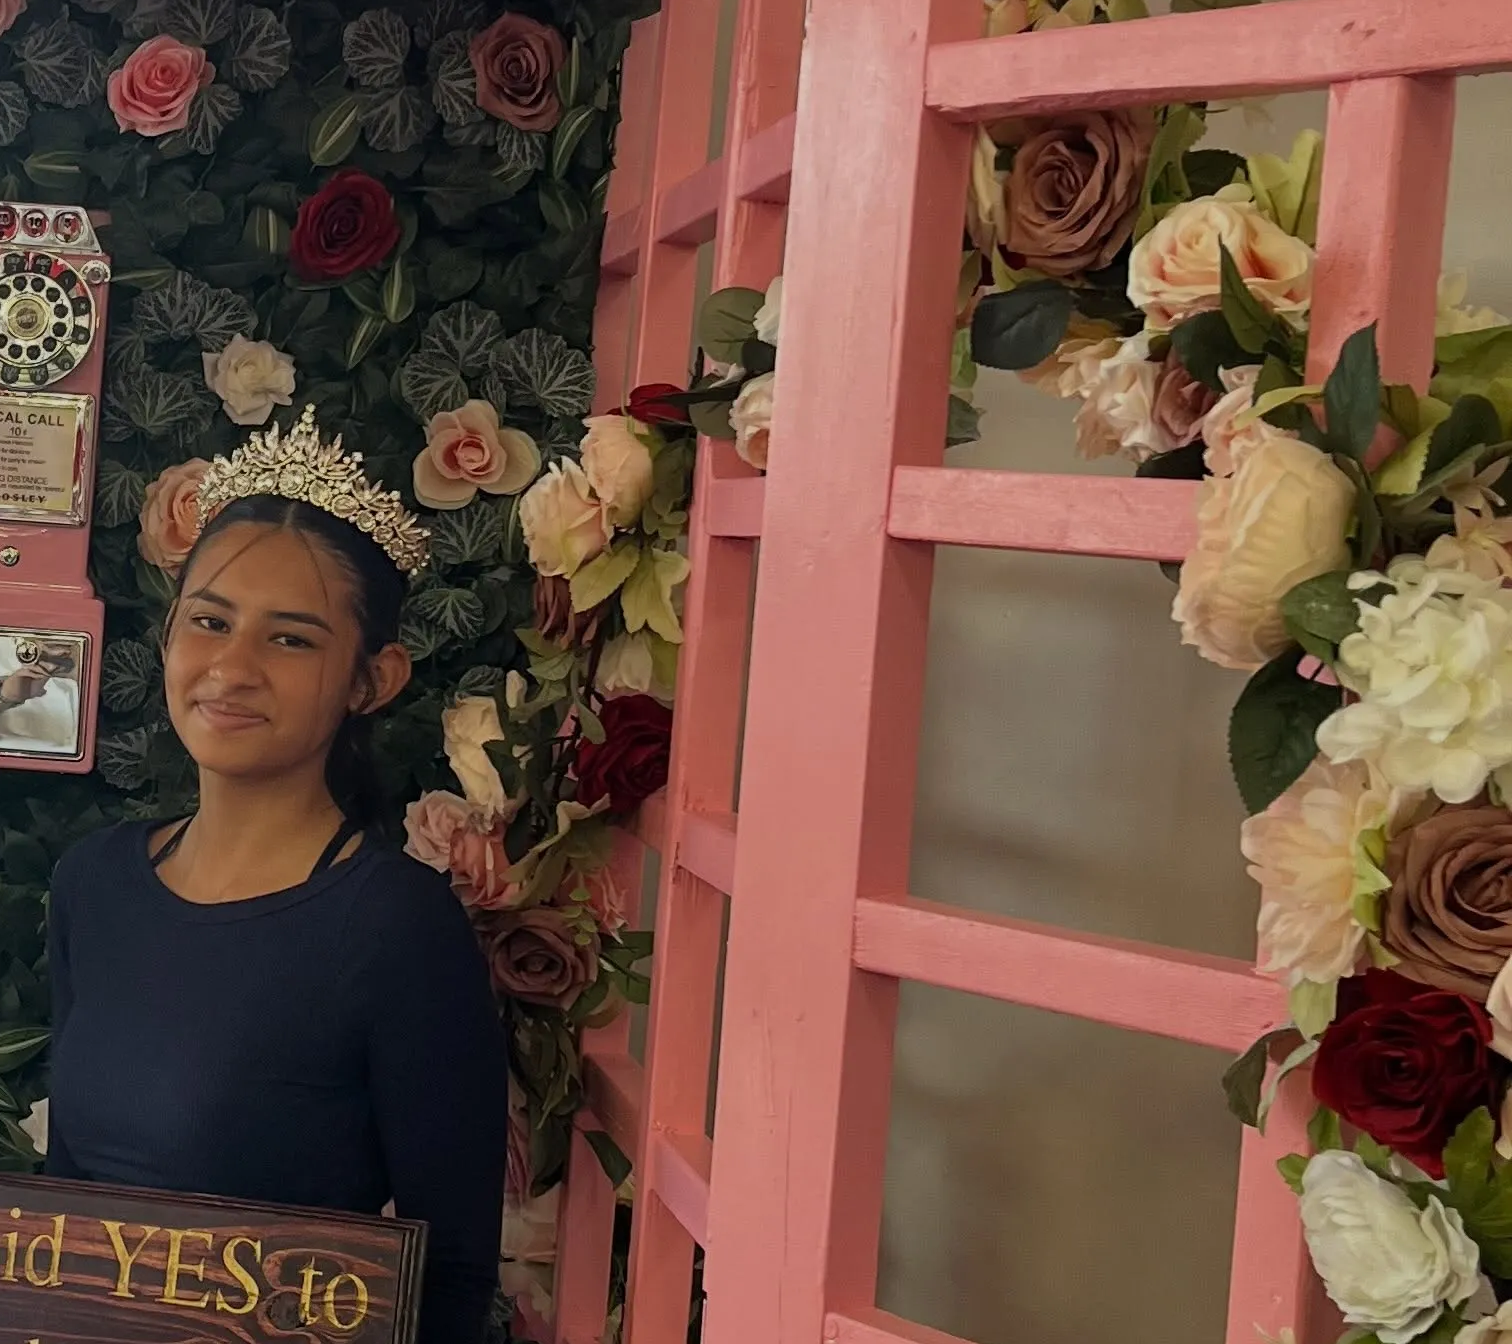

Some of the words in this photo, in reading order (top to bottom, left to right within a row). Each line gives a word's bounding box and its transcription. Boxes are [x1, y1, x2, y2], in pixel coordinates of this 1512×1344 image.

[28, 413, 64, 426] CALL
[10, 427, 21, 436] 10
[7, 475, 48, 486] DISTANCE
[102, 1220, 263, 1314] YES
[298, 1255, 369, 1331] to
